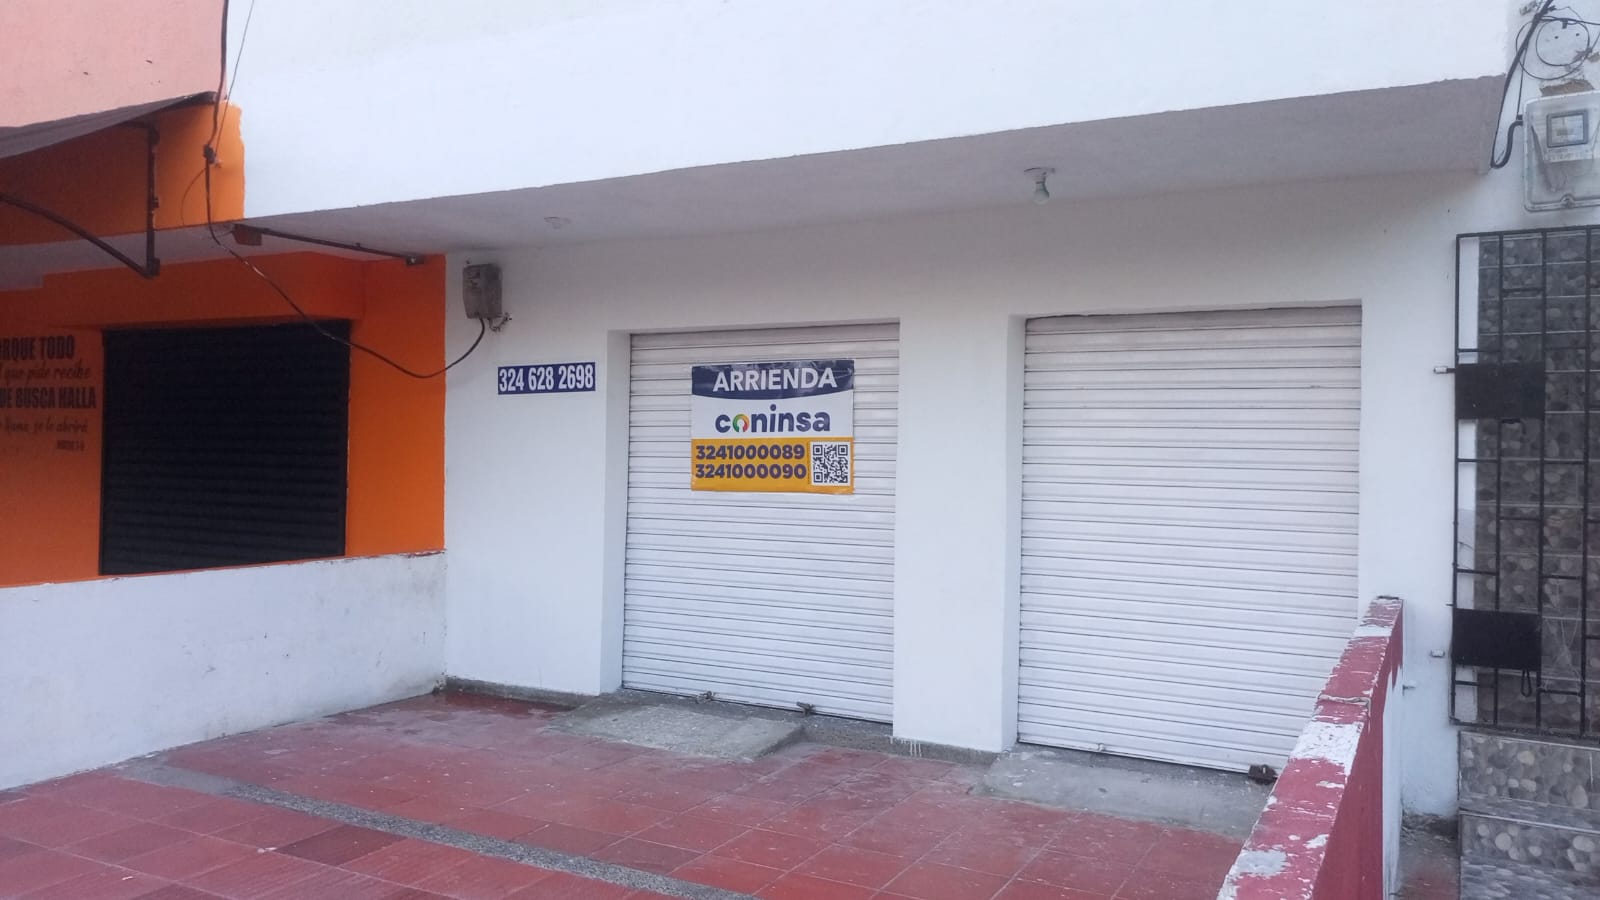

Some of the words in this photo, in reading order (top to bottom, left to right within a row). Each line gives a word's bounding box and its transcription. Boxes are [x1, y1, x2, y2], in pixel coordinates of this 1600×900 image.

[0, 337, 36, 361] RQUE
[40, 335, 75, 359] TODO
[499, 368, 525, 392] 324
[528, 366, 554, 391] 628
[558, 364, 594, 389] 2698
[713, 367, 838, 392] ARRIENDA
[15, 386, 56, 409] BUSCA
[58, 386, 97, 409] HALLA
[715, 404, 831, 433] coninsa
[695, 444, 806, 460] 3241000089
[695, 463, 807, 479] 3241000090
